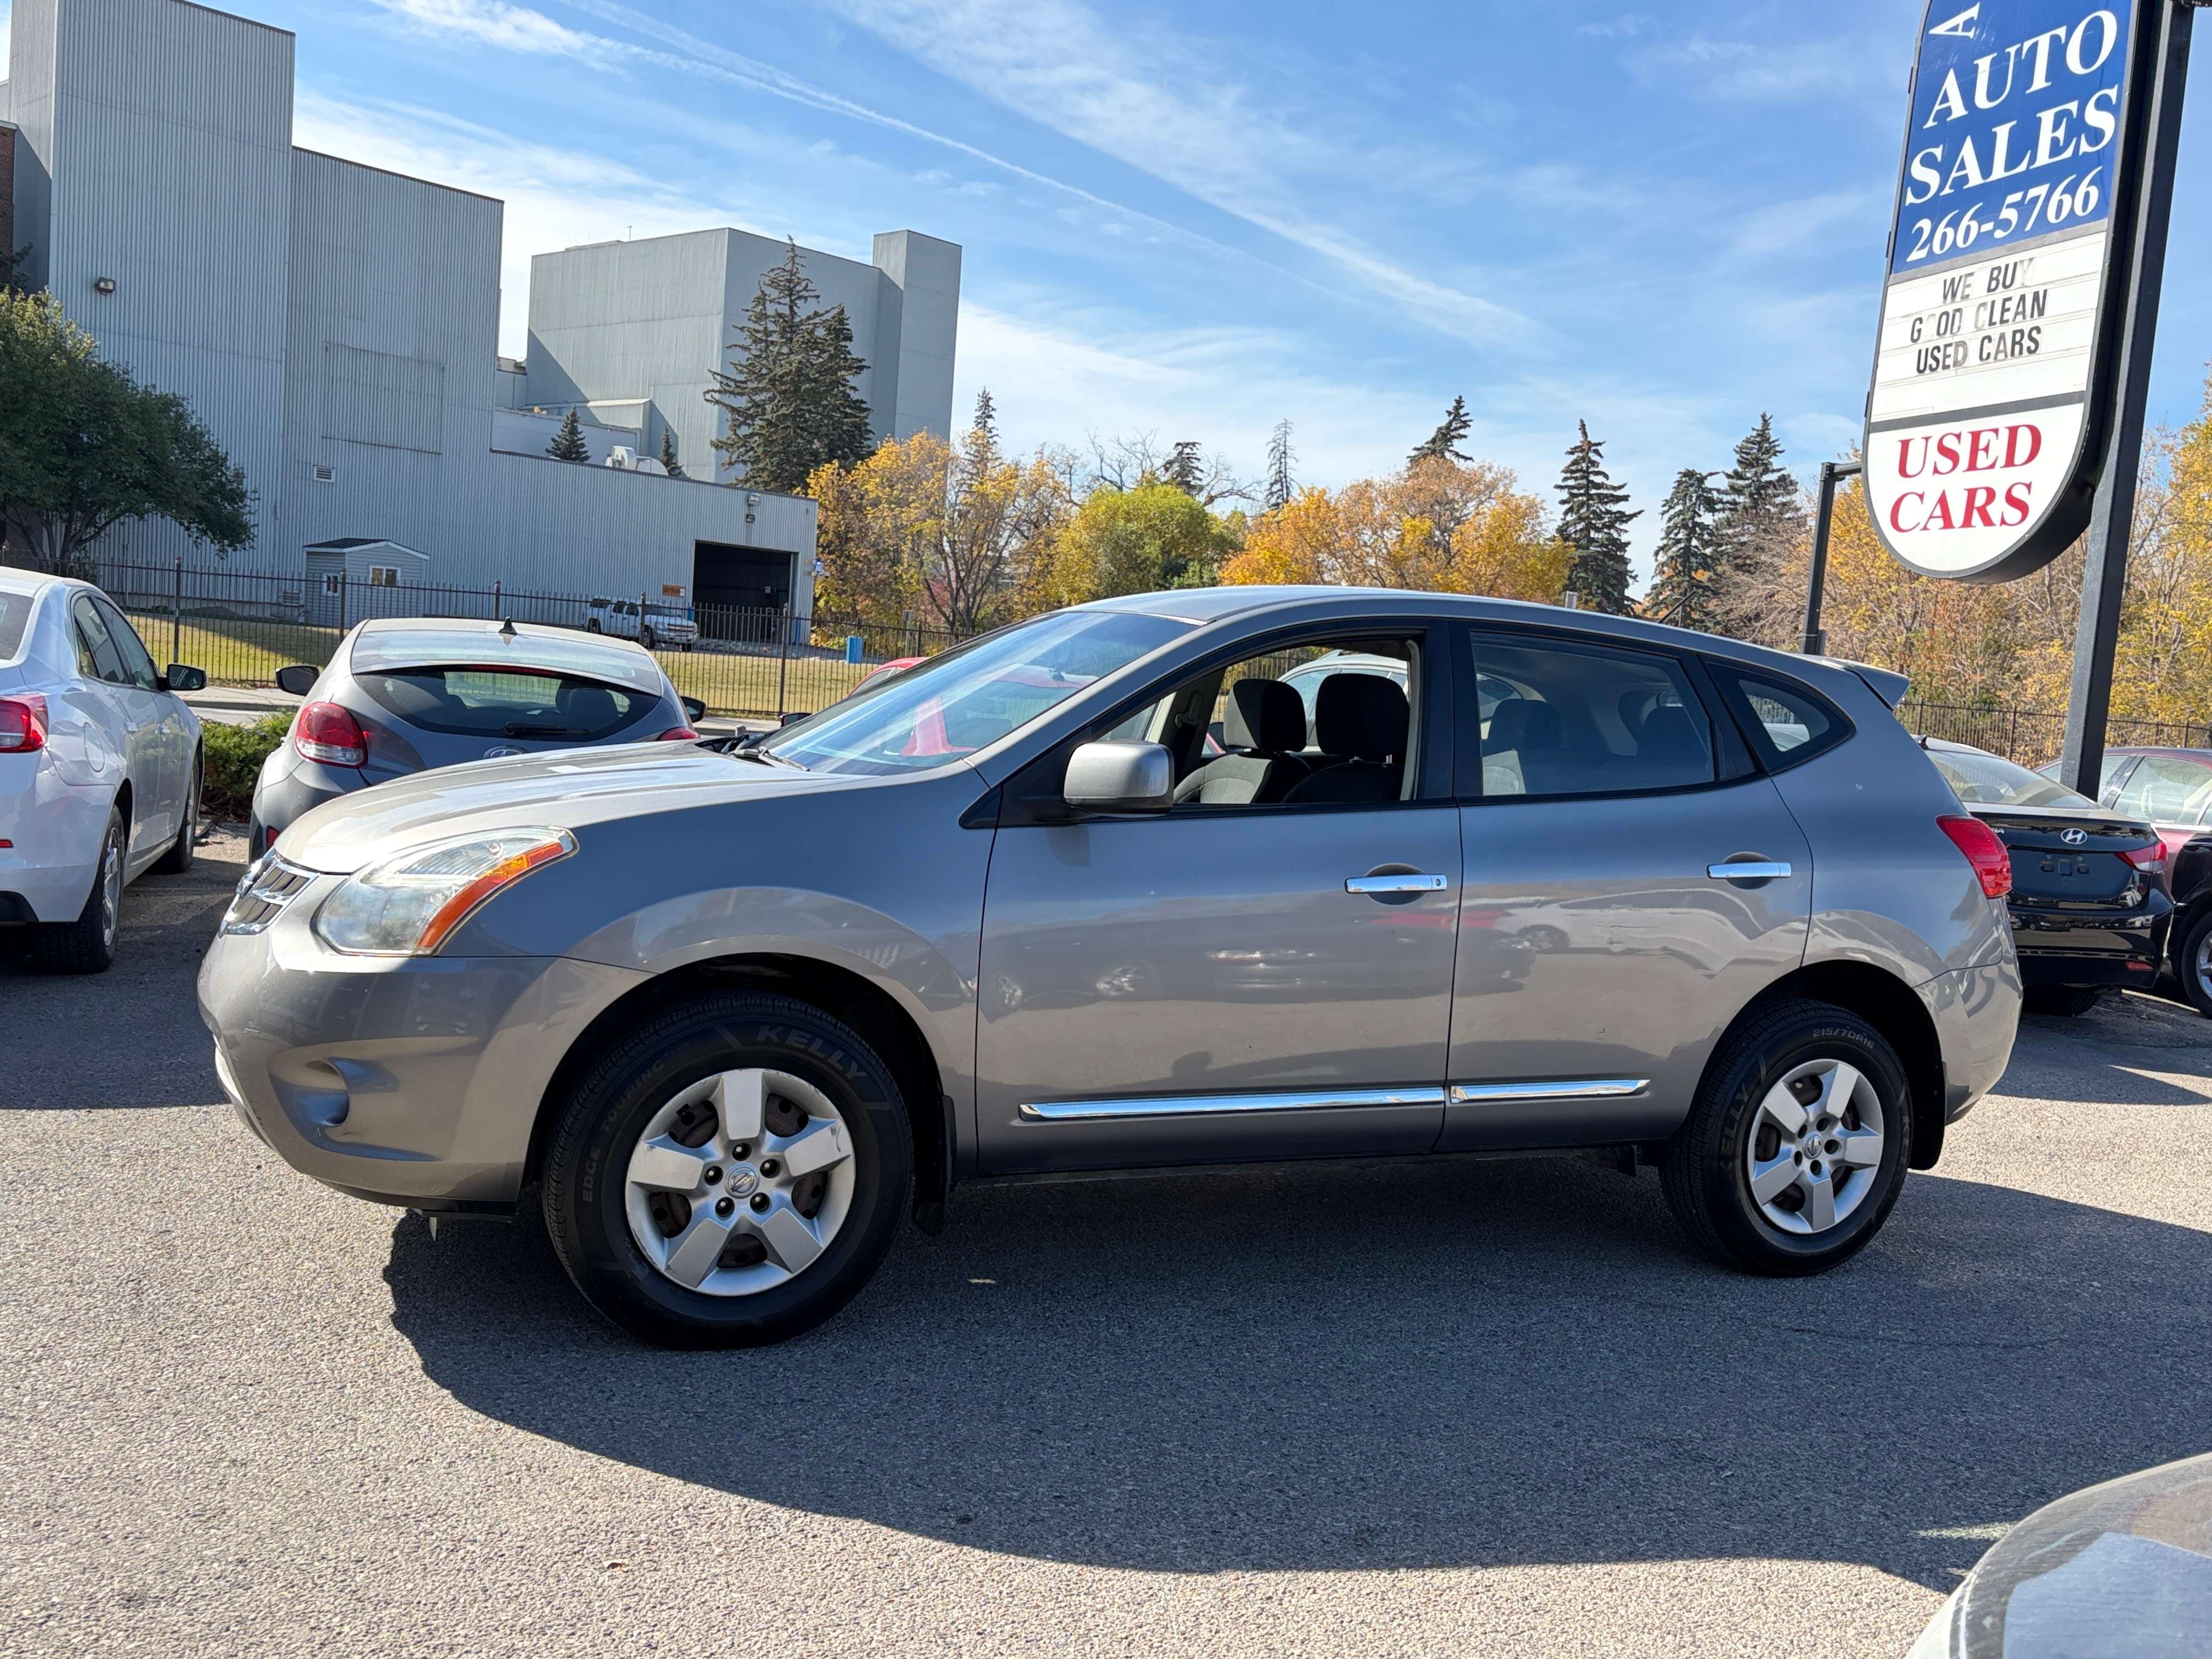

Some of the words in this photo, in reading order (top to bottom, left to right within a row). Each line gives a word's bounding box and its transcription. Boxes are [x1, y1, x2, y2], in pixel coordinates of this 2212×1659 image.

[1923, 10, 2118, 129] AUTO
[1905, 84, 2118, 207] SALES
[1906, 166, 2103, 262] 266-5766
[1943, 272, 1974, 303] WE
[1974, 289, 2048, 330] CLEAN
[1916, 340, 1968, 374] USED
[1979, 326, 2041, 362] CARS
[1897, 424, 2042, 478] USED
[1890, 481, 2033, 533] CARS
[757, 1024, 867, 1080] KELLY
[1812, 1027, 1875, 1049] 215/70R16
[582, 1145, 601, 1203] EDGE
[601, 1059, 665, 1133] TOURING
[1720, 1082, 1749, 1173] KELLY
